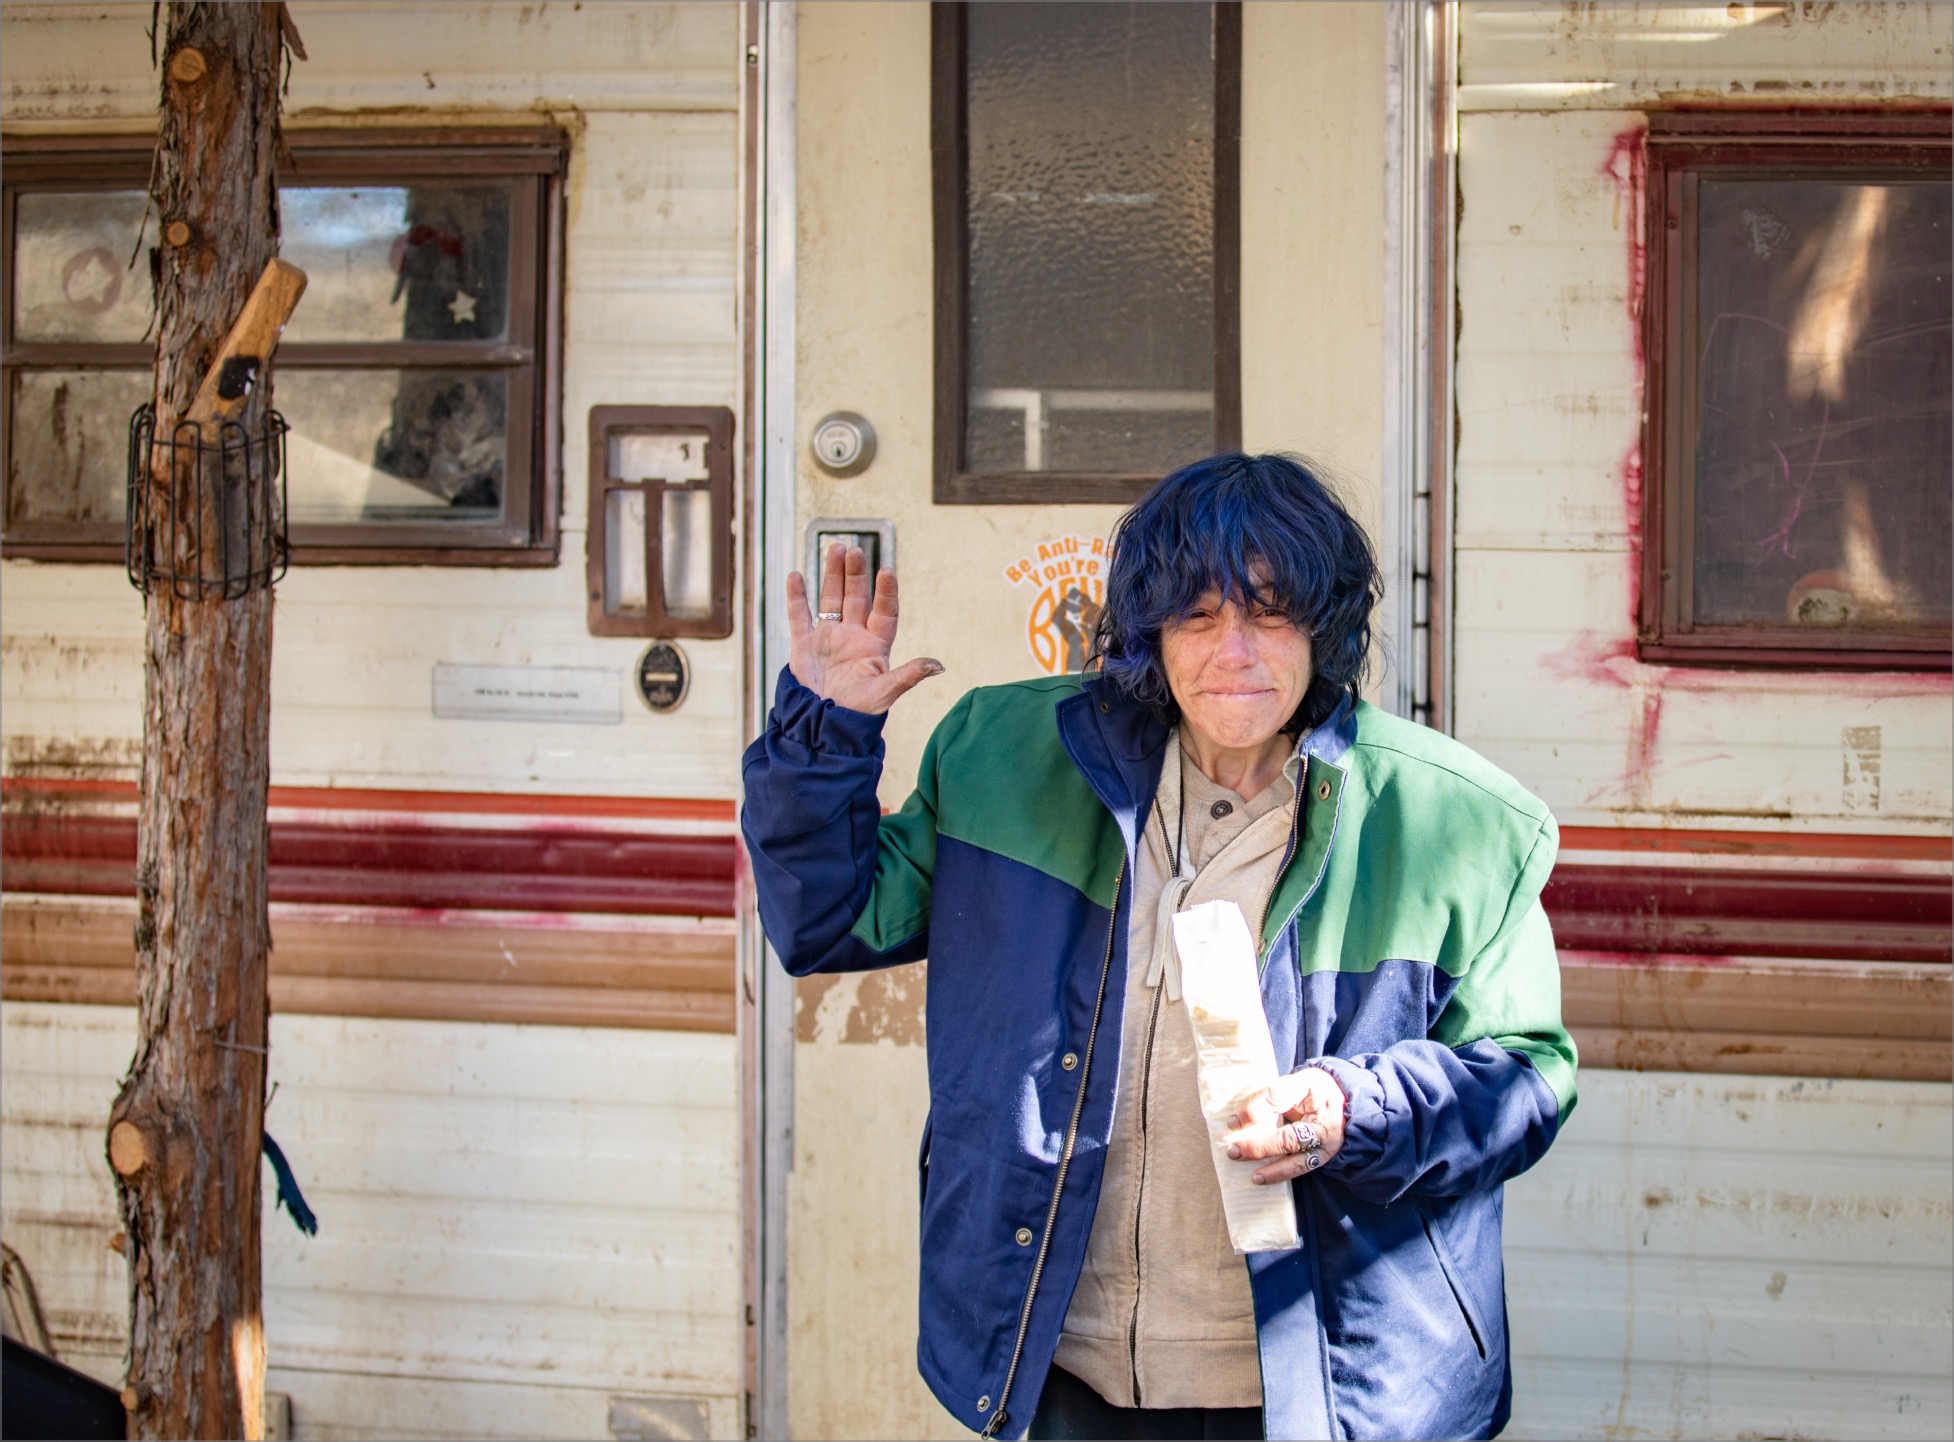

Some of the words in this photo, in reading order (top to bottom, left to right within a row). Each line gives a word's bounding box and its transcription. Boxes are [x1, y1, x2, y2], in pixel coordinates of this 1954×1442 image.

[1005, 559, 1032, 583] Be
[1037, 536, 1117, 562] Anti-Ra
[1028, 556, 1100, 588] You're
